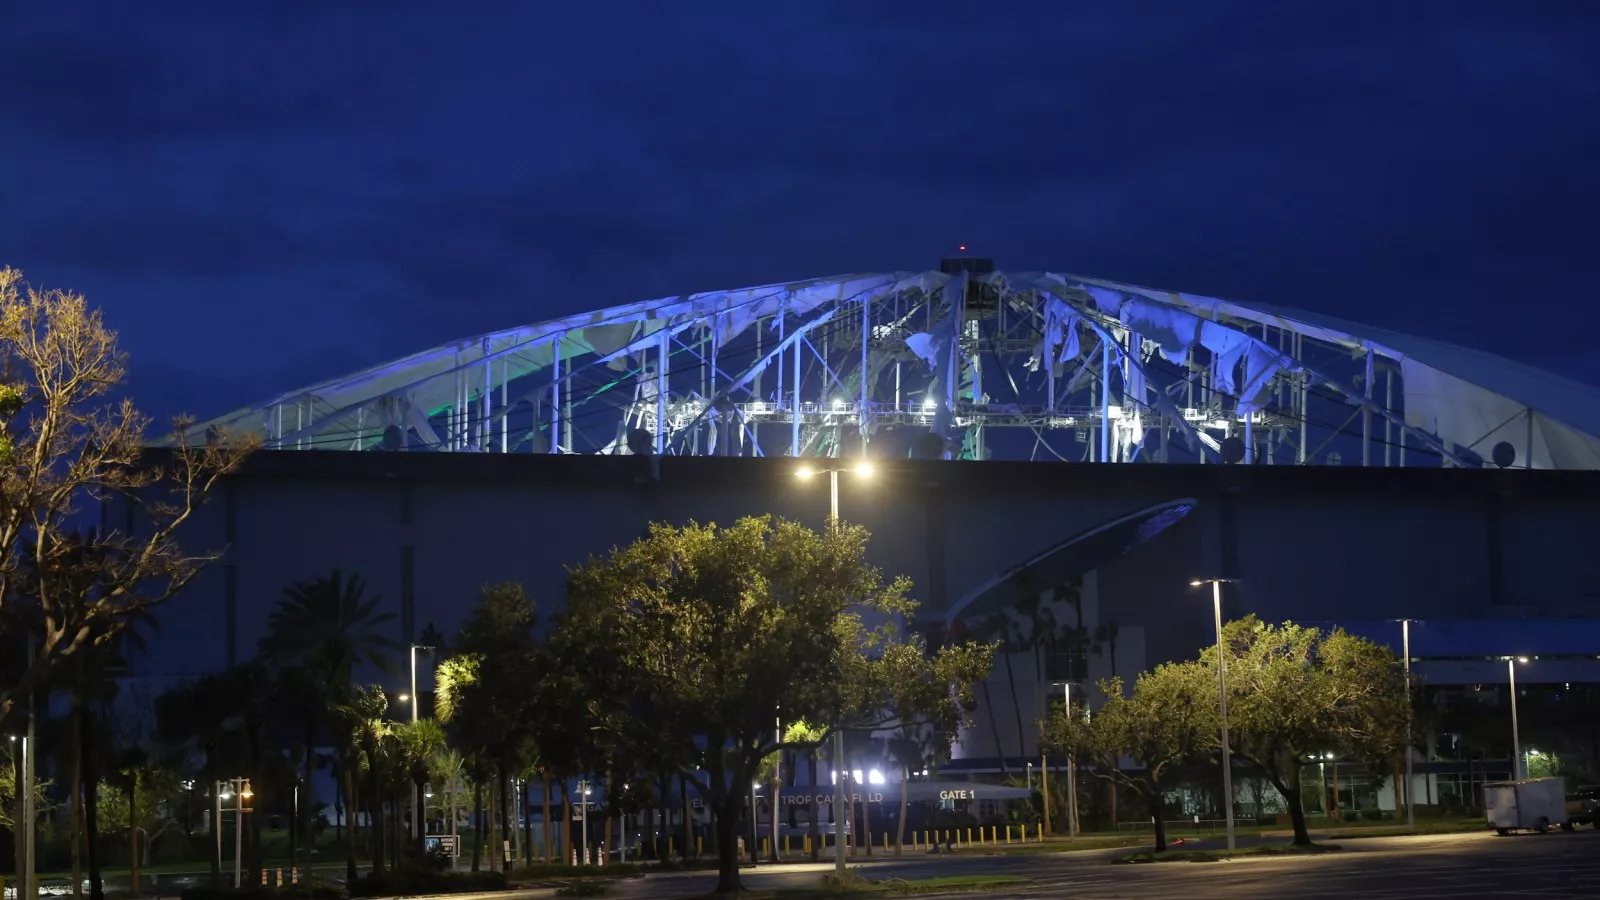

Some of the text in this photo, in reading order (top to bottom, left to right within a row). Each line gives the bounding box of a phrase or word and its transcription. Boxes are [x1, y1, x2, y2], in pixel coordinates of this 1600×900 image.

[780, 793, 883, 805] TROPCAA FILD
[939, 790, 975, 800] GATE 1
